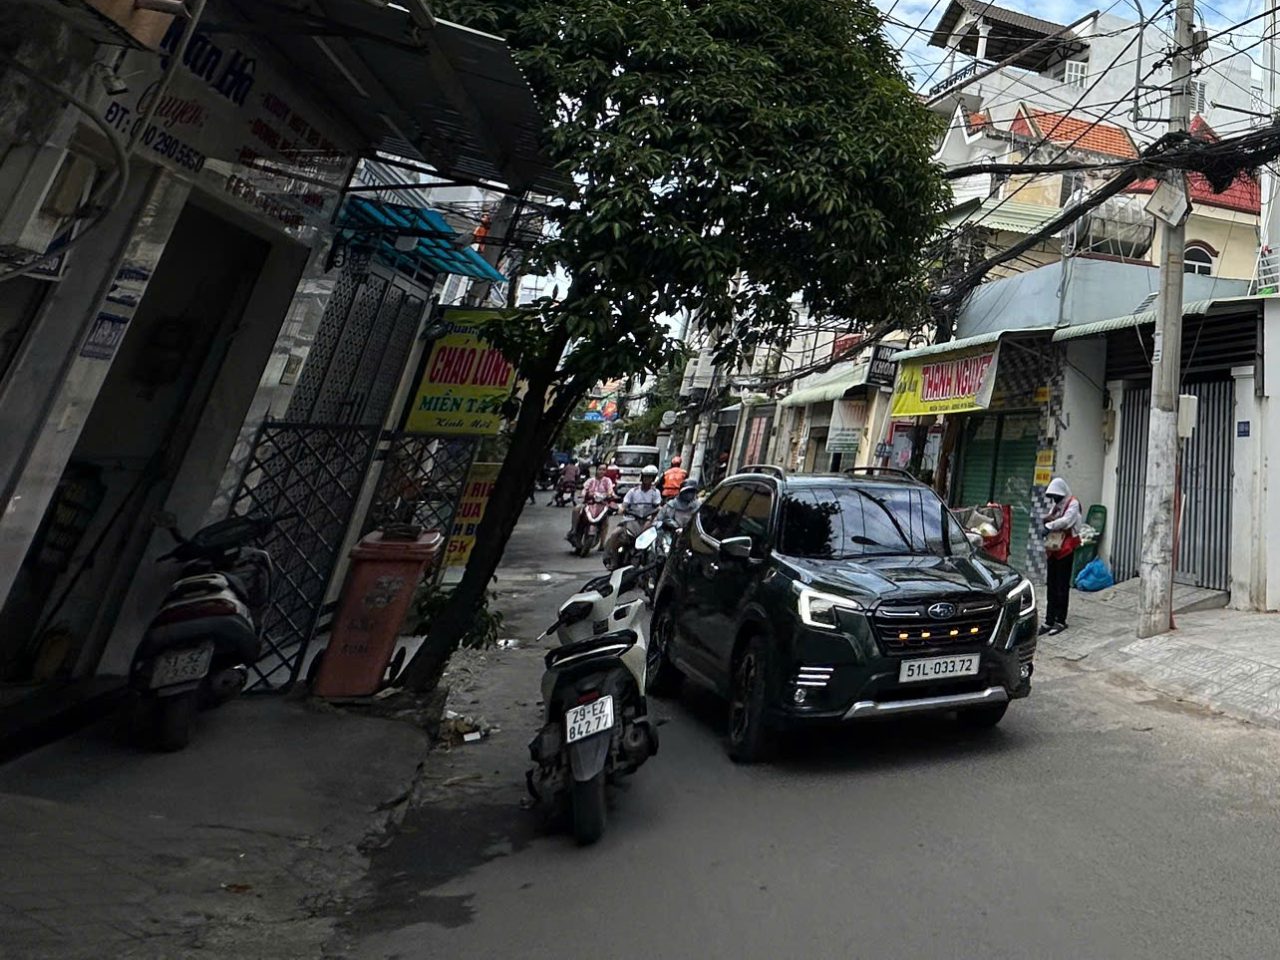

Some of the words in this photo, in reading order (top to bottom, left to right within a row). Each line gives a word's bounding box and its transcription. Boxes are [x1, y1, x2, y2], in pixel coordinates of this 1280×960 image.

[105, 101, 131, 133] ĐT:
[871, 360, 895, 376] KHOA
[921, 363, 951, 401] THANH
[419, 389, 464, 412] MIỀN
[569, 713, 609, 740] 842.77
